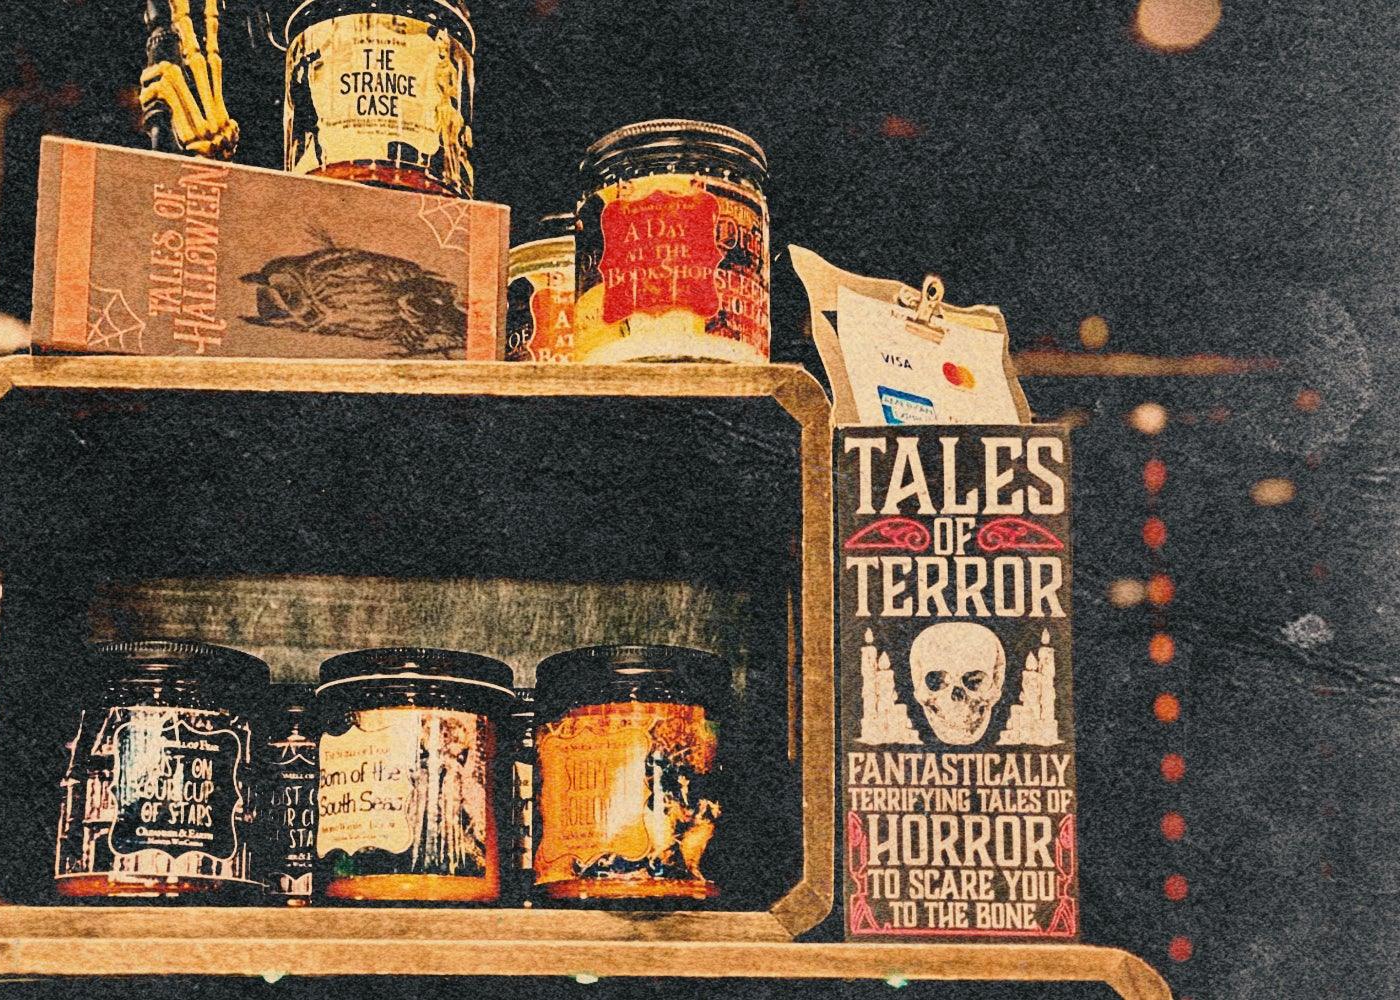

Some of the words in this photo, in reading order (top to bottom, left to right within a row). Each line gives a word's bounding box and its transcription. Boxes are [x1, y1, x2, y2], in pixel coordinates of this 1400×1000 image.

[363, 48, 395, 71] THE
[340, 71, 417, 98] STRANGE
[356, 94, 399, 117] CASE
[154, 183, 186, 219] OF
[623, 222, 640, 243] A
[646, 218, 687, 239] DAY
[173, 163, 232, 354] HALLOWEEN
[655, 243, 691, 260] THE
[149, 229, 184, 317] TALES
[607, 258, 712, 289] BOOKSHOP
[881, 352, 913, 370] VISA
[844, 437, 1065, 514] TALES
[933, 517, 976, 555] OF
[846, 556, 1066, 617] TERROR
[192, 758, 213, 780] ON
[351, 761, 368, 783] of
[848, 752, 1071, 787] FANTASTICALLY
[183, 781, 214, 803] CUP
[320, 792, 356, 817] South
[848, 787, 971, 812] TERRIFYING
[977, 788, 1041, 812] TALES
[1047, 789, 1073, 813] OF
[141, 802, 162, 823] OF
[168, 802, 213, 827] STARS
[866, 814, 1056, 867] HORROR
[867, 868, 900, 899] TO
[909, 868, 995, 900] SCARE
[1003, 870, 1056, 900] YOU
[889, 901, 918, 928] TO
[922, 901, 970, 928] THE
[976, 902, 1038, 928] BONE
